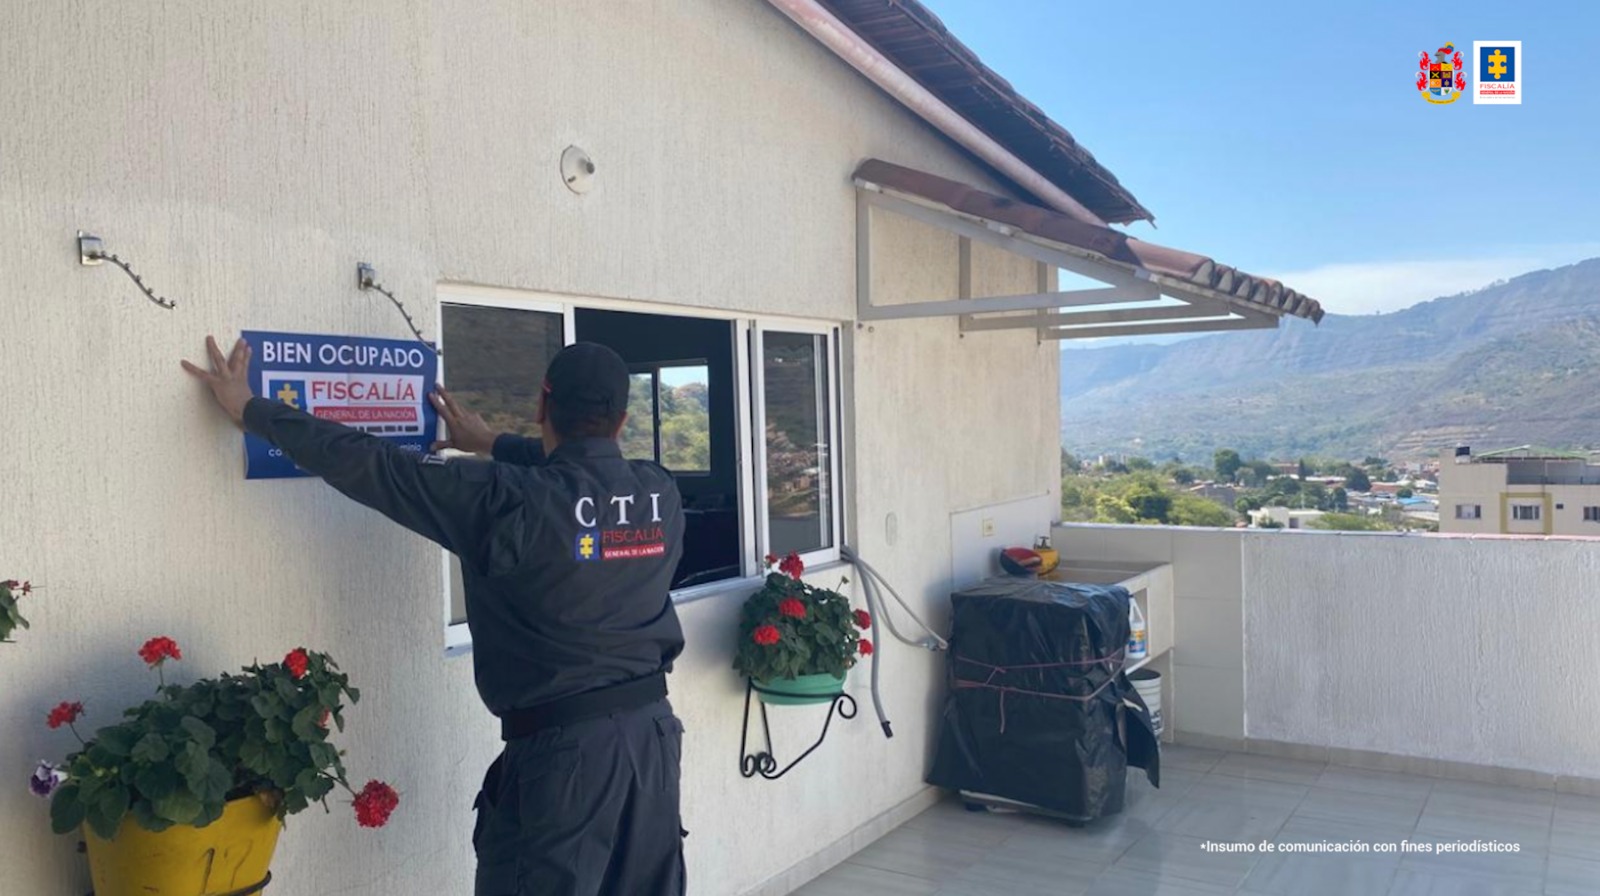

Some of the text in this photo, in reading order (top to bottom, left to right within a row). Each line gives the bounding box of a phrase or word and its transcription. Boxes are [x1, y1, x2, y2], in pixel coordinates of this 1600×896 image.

[262, 341, 424, 368] BIEN OCUPADO
[312, 378, 415, 401] FISCALÍA
[358, 410, 370, 419] DE
